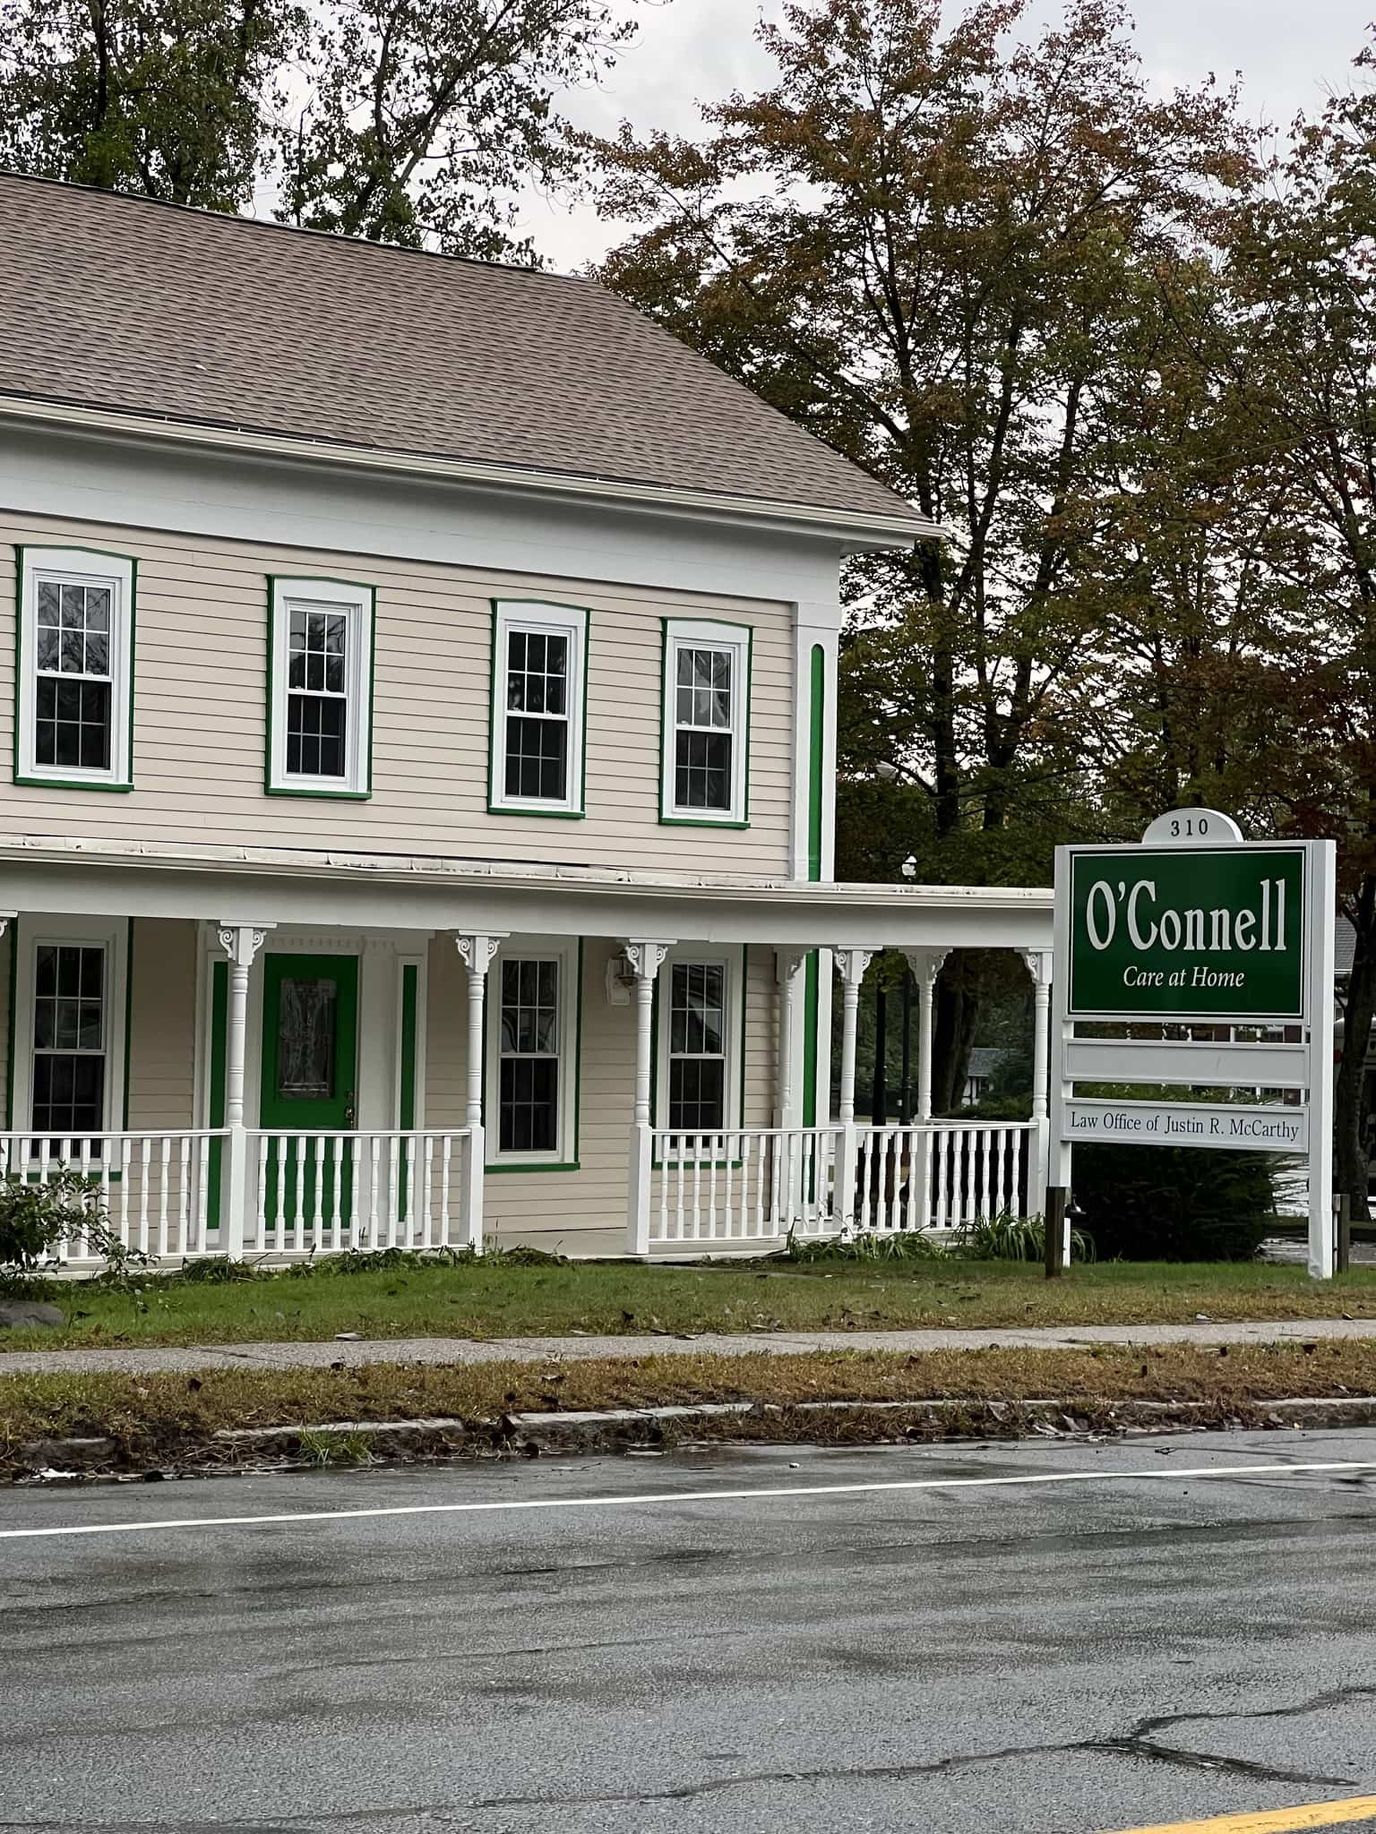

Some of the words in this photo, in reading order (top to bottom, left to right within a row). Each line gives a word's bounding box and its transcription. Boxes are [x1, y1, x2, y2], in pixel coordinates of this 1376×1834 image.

[1171, 818, 1208, 837] 310
[1123, 966, 1164, 987] Care
[1168, 968, 1187, 987] at
[1190, 966, 1245, 987] Home
[1071, 1111, 1098, 1128] Law
[1103, 1112, 1141, 1131] Office
[1146, 1115, 1160, 1132] of
[1164, 1116, 1204, 1134] Justin
[1209, 1118, 1224, 1134] R.
[1229, 1118, 1299, 1141] McCarthy
